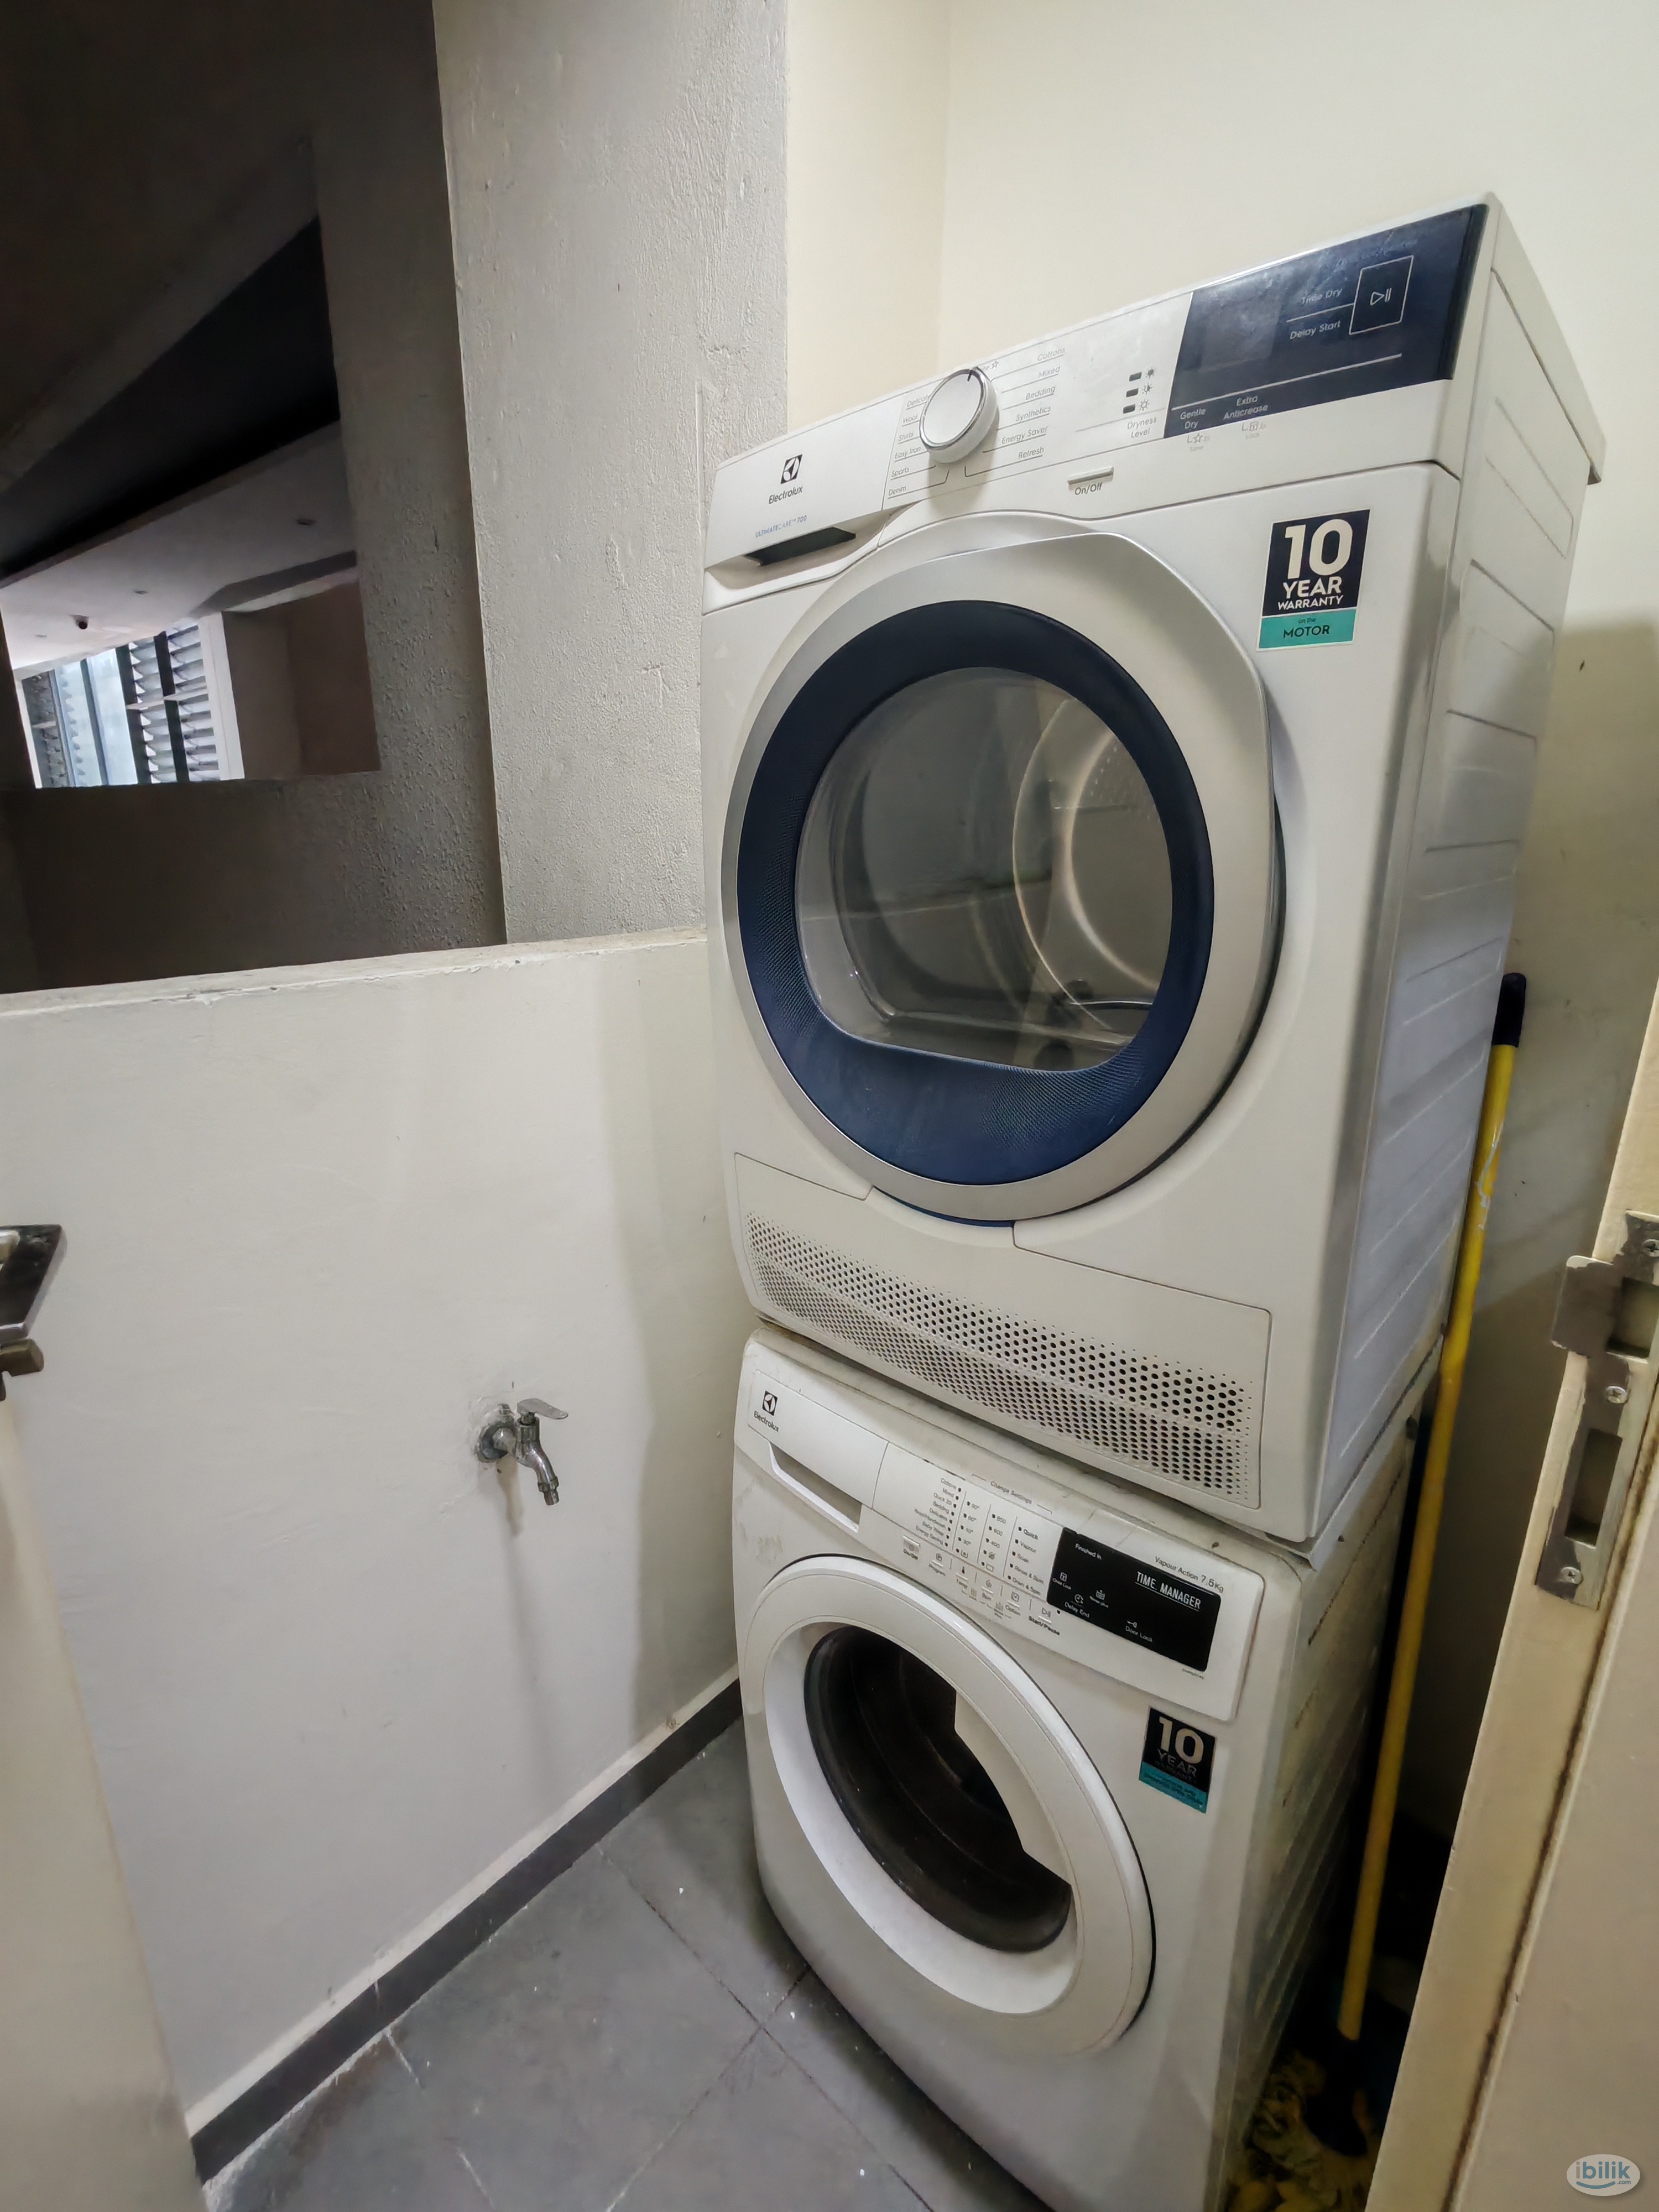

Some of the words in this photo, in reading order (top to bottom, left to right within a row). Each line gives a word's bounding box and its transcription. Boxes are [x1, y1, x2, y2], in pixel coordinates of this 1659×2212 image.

[1326, 289, 1343, 299] Dry
[1290, 327, 1316, 340] Delay
[1319, 320, 1341, 332] Start
[1037, 347, 1066, 362] Cottons
[1038, 366, 1061, 378] Mixed
[1025, 386, 1056, 400] Bedding
[906, 394, 930, 408] Delicat
[1237, 395, 1258, 406] Extra
[902, 414, 919, 424] Wool
[1015, 406, 1051, 421] Synthetics
[1180, 408, 1206, 420] Gentle
[1223, 405, 1268, 420] Anticrease
[1127, 416, 1157, 430] Dryness
[1185, 420, 1198, 430] Dry
[1001, 433, 1026, 444] Energy
[1027, 426, 1048, 437] Saver
[1130, 427, 1151, 439] Level
[894, 450, 909, 460] Easy
[909, 446, 922, 455] Iron
[1018, 446, 1045, 460] Refresh
[891, 467, 910, 478] Sports
[768, 486, 803, 504] Electrolux
[888, 485, 907, 496] Denim
[1074, 482, 1103, 495] On/Off
[1284, 518, 1353, 580] 10
[1282, 576, 1343, 599] YEAR
[1277, 594, 1344, 611] WARRANTY
[1283, 625, 1331, 639] MOTOR
[754, 1410, 779, 1433] Electrolux
[1155, 1556, 1177, 1571] Vapour
[1178, 1567, 1198, 1580] Action
[1160, 1582, 1201, 1609] MANAGER
[1065, 1601, 1078, 1613] Delay
[1079, 1609, 1090, 1618] End
[1125, 1626, 1139, 1636] Door
[1139, 1632, 1153, 1642] Lock
[1159, 1715, 1204, 1764] 10
[1157, 1748, 1197, 1777] YEAR
